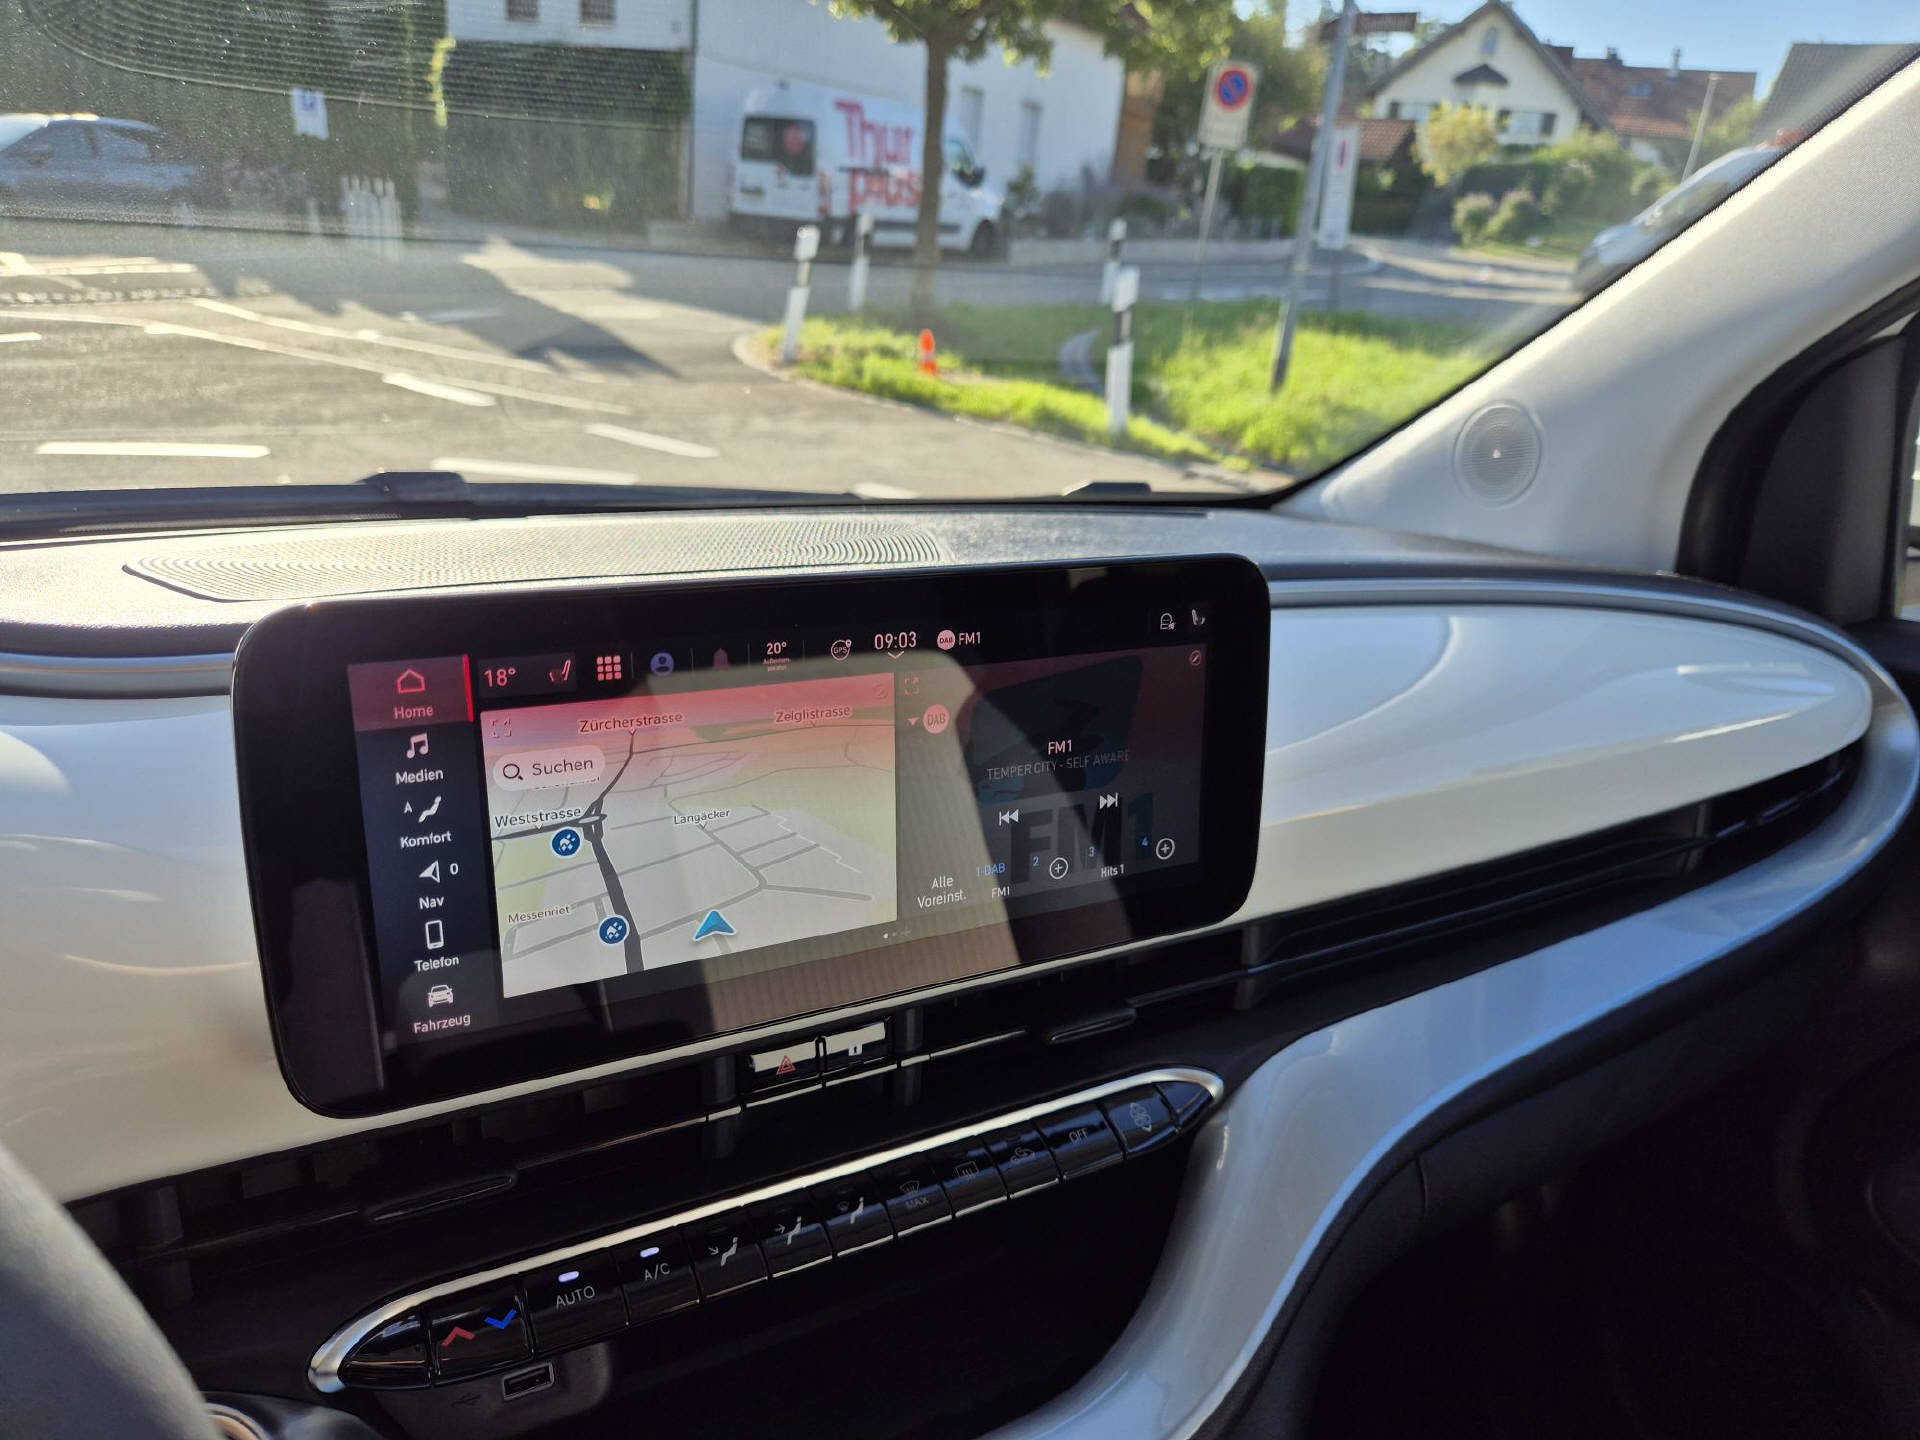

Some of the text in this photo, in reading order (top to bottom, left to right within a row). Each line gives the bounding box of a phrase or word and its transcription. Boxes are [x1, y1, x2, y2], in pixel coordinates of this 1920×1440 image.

[874, 631, 917, 650] 09:03
[959, 631, 981, 646] FM1
[767, 641, 787, 655] 20°
[833, 645, 849, 655] GPS
[484, 667, 516, 688] 18°
[393, 704, 434, 720] Home
[775, 706, 851, 723] Zeiglistrasse
[928, 711, 946, 727] DAB
[579, 712, 684, 734] Zürcherstrasse
[1048, 739, 1073, 755] FM1
[532, 757, 594, 777] Suchen
[987, 763, 1032, 780] TEMPER
[1033, 759, 1057, 774] CITY
[1066, 756, 1090, 769] SELF
[1093, 749, 1130, 765] AWARE
[394, 767, 444, 785] Medien
[494, 807, 582, 829] Weststrasse
[400, 830, 452, 849] Komfort
[1088, 847, 1095, 858] 3
[1032, 856, 1039, 867] 2
[1100, 863, 1125, 878] Hits 1
[932, 876, 954, 890] Alle
[917, 889, 967, 909] Voreinst.
[991, 886, 1010, 899] FM1
[419, 897, 445, 910] Nav
[508, 905, 570, 924] Messenriet
[414, 956, 460, 972] Telefon
[413, 1014, 471, 1034] Fahrzeug
[1069, 1128, 1089, 1145] OFF
[643, 1262, 671, 1281] A/C
[556, 1286, 596, 1309] AUTO
